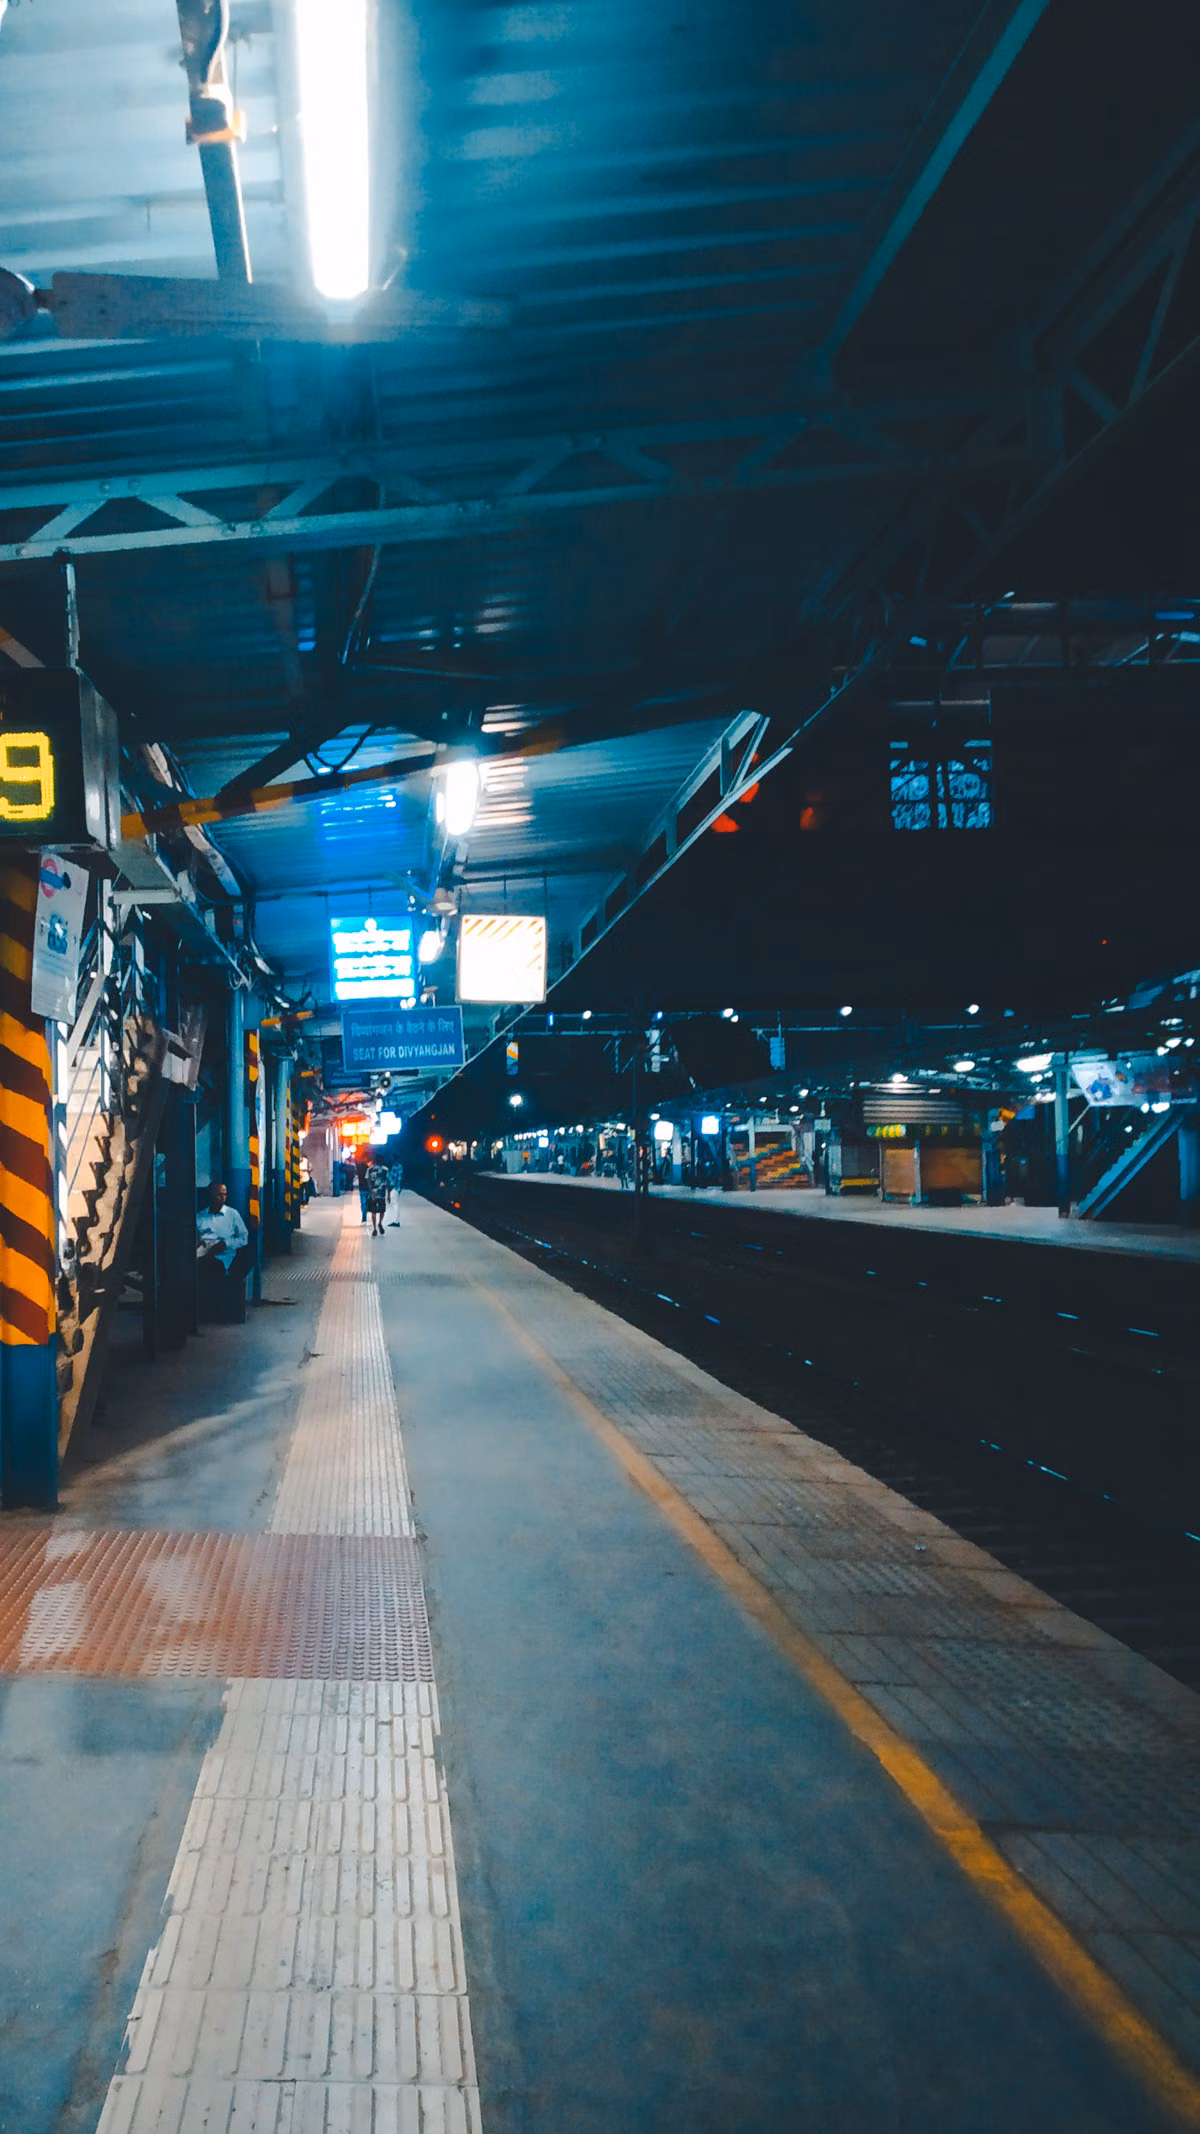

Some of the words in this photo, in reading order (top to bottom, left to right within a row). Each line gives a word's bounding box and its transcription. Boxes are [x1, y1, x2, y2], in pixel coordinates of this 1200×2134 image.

[353, 1046, 376, 1060] SEAT
[378, 1046, 396, 1059] FOR
[398, 1043, 455, 1058] DIVYANGJAN
